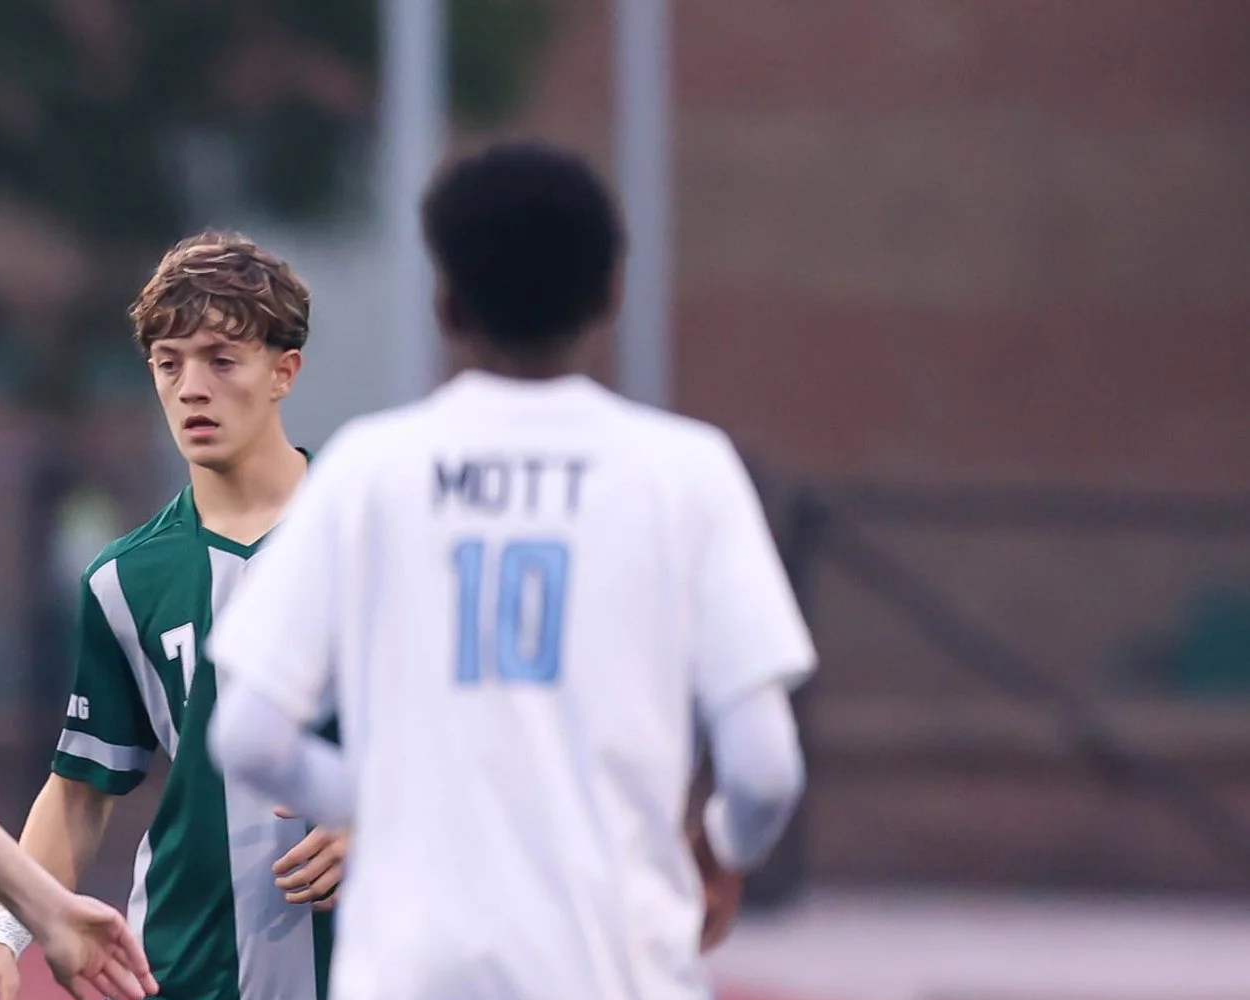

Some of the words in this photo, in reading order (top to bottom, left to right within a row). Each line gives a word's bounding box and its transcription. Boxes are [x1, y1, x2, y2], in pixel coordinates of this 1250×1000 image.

[432, 456, 592, 515] MOTT
[450, 538, 569, 687] 10
[160, 621, 197, 707] 7
